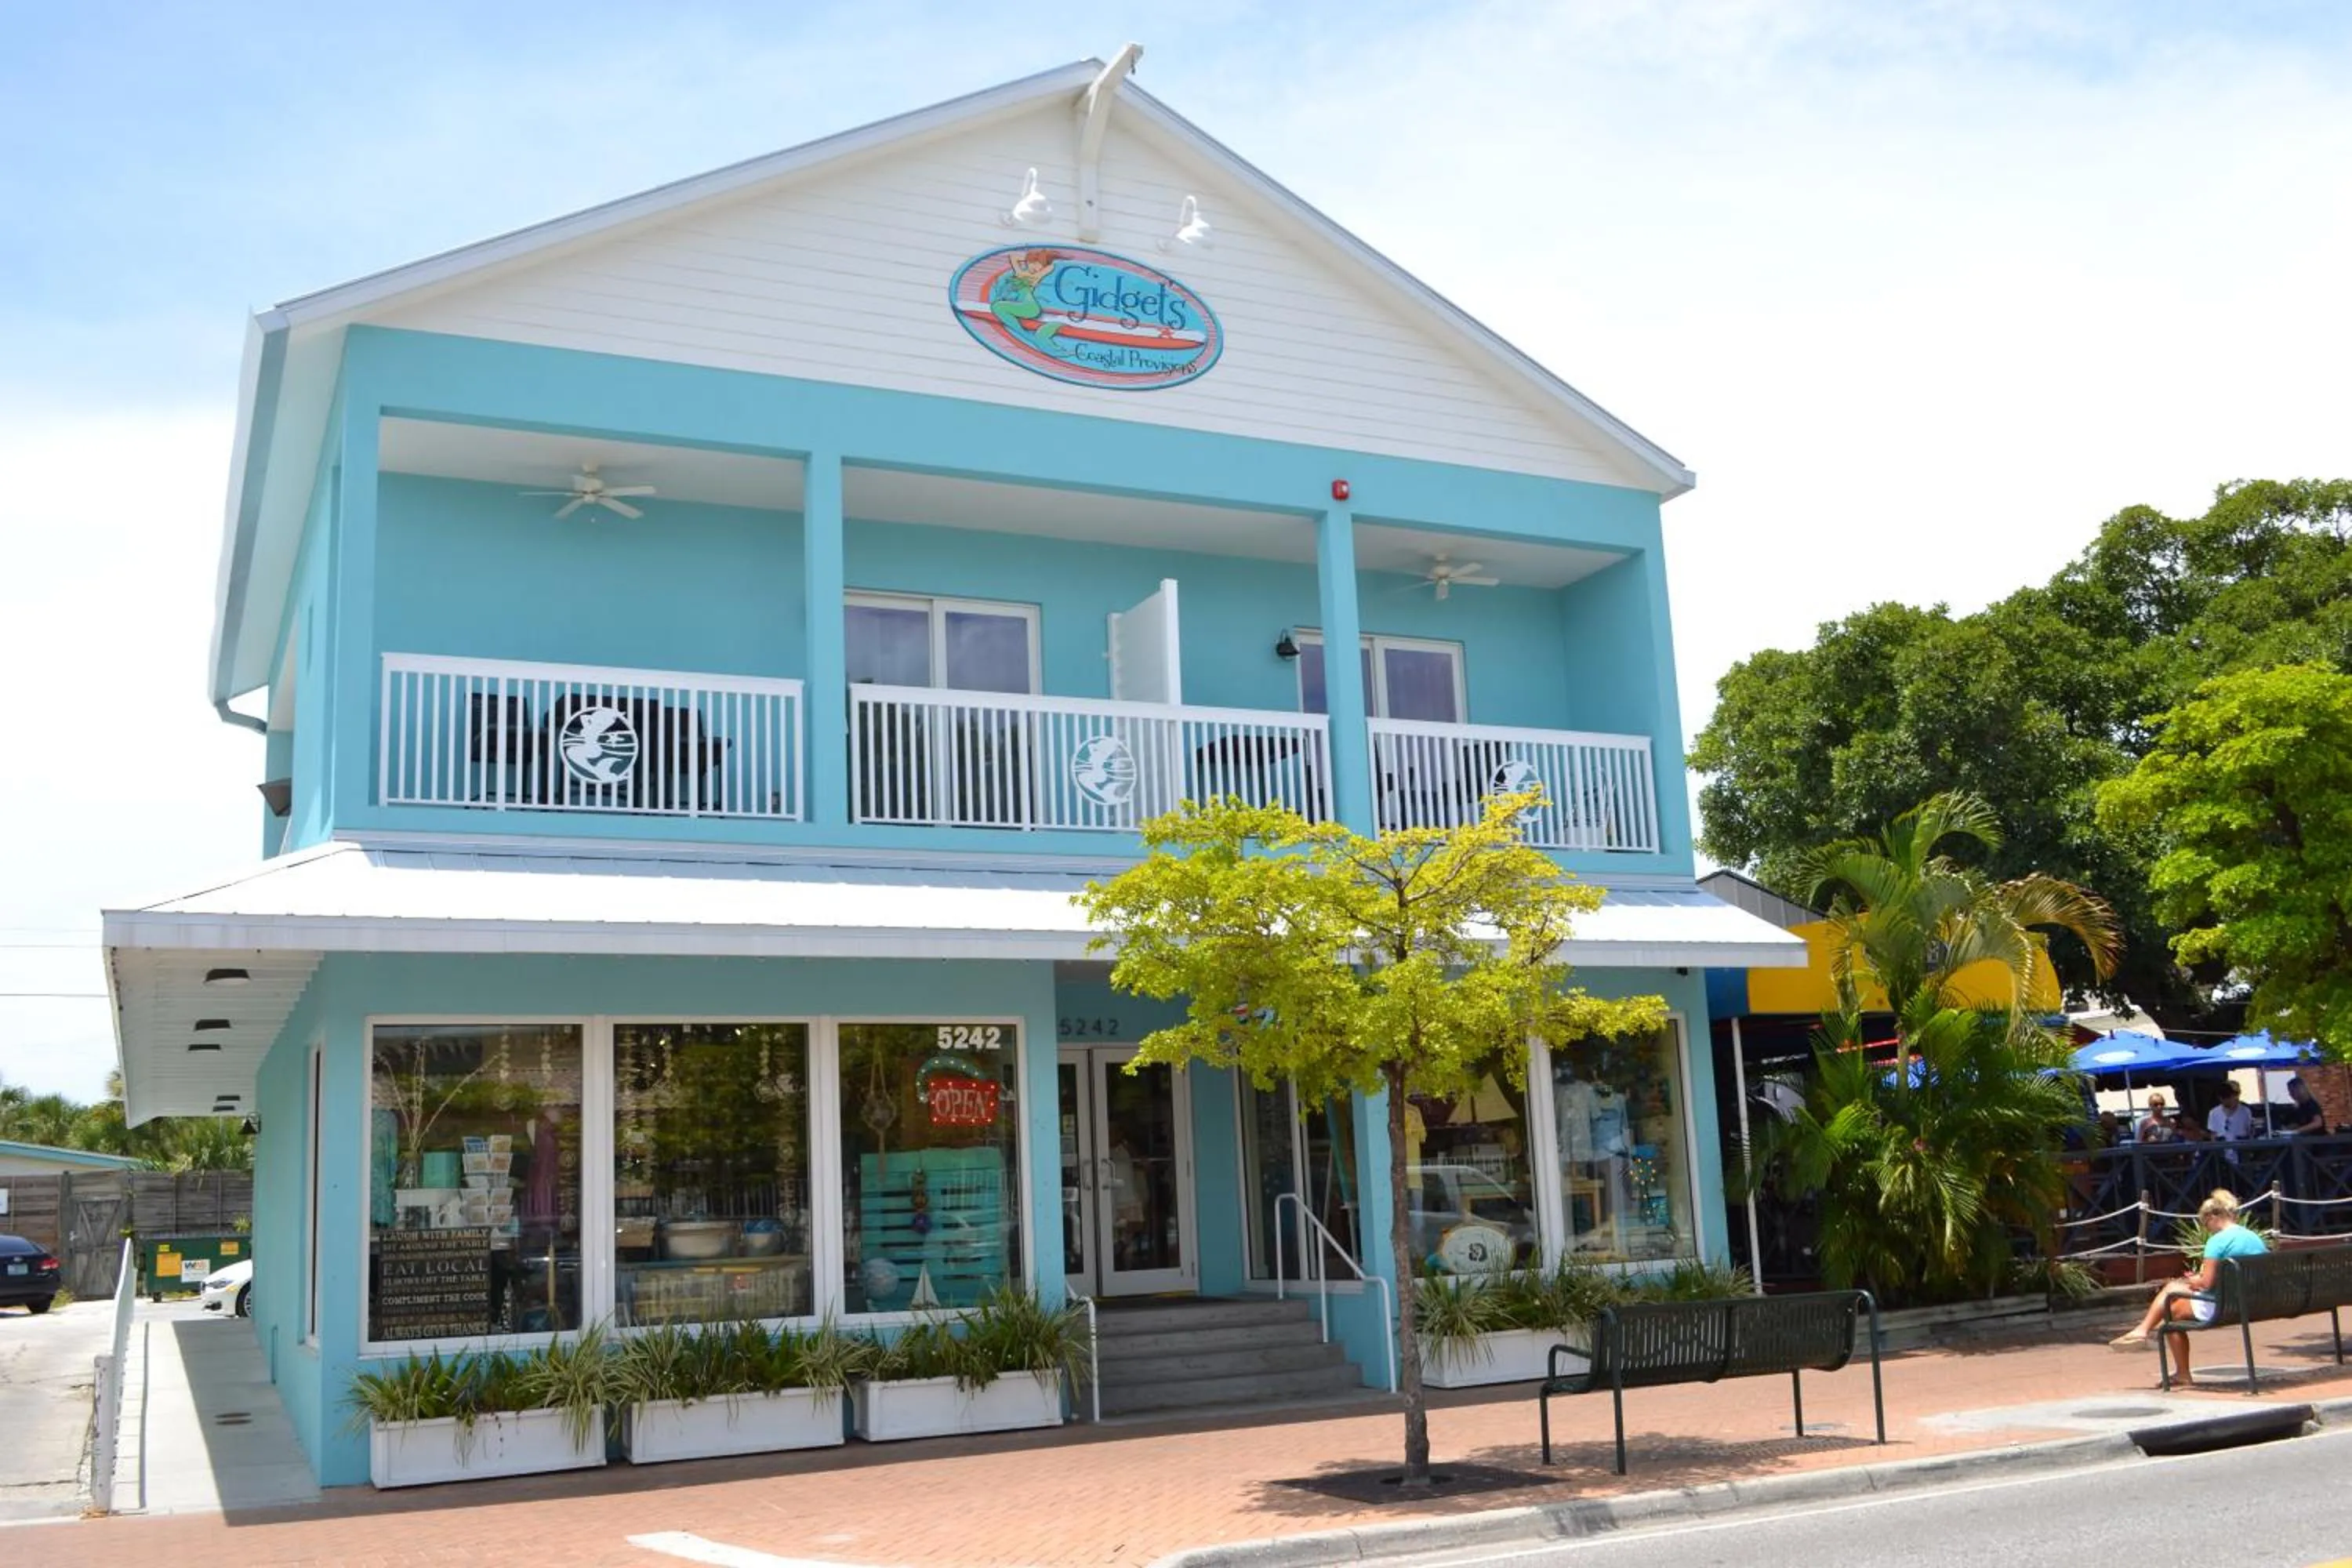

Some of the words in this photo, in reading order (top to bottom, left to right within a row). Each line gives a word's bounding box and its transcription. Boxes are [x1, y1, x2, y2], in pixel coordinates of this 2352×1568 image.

[1075, 343, 1124, 368] Coastal
[1129, 350, 1197, 376] Provisions
[1058, 1016, 1120, 1036] 5242
[937, 1026, 1001, 1050] 5242
[935, 1088, 990, 1119] OPEN
[383, 1231, 419, 1242] LAUGH
[422, 1230, 448, 1240] WITH
[451, 1229, 488, 1239] FAMILY
[399, 1241, 438, 1250] AROUND
[441, 1240, 457, 1249] THE
[460, 1240, 488, 1248] TABLE
[383, 1261, 416, 1276] EAT
[425, 1258, 488, 1274] LOCAL
[441, 1275, 458, 1284] THE
[460, 1273, 488, 1283] TABLE
[382, 1294, 441, 1305] COMPLIMENT
[444, 1293, 460, 1302] THE
[463, 1291, 488, 1301] COOK
[383, 1325, 422, 1339] ALWAYS
[423, 1323, 448, 1337] GIVE
[448, 1321, 488, 1334] THANKS
